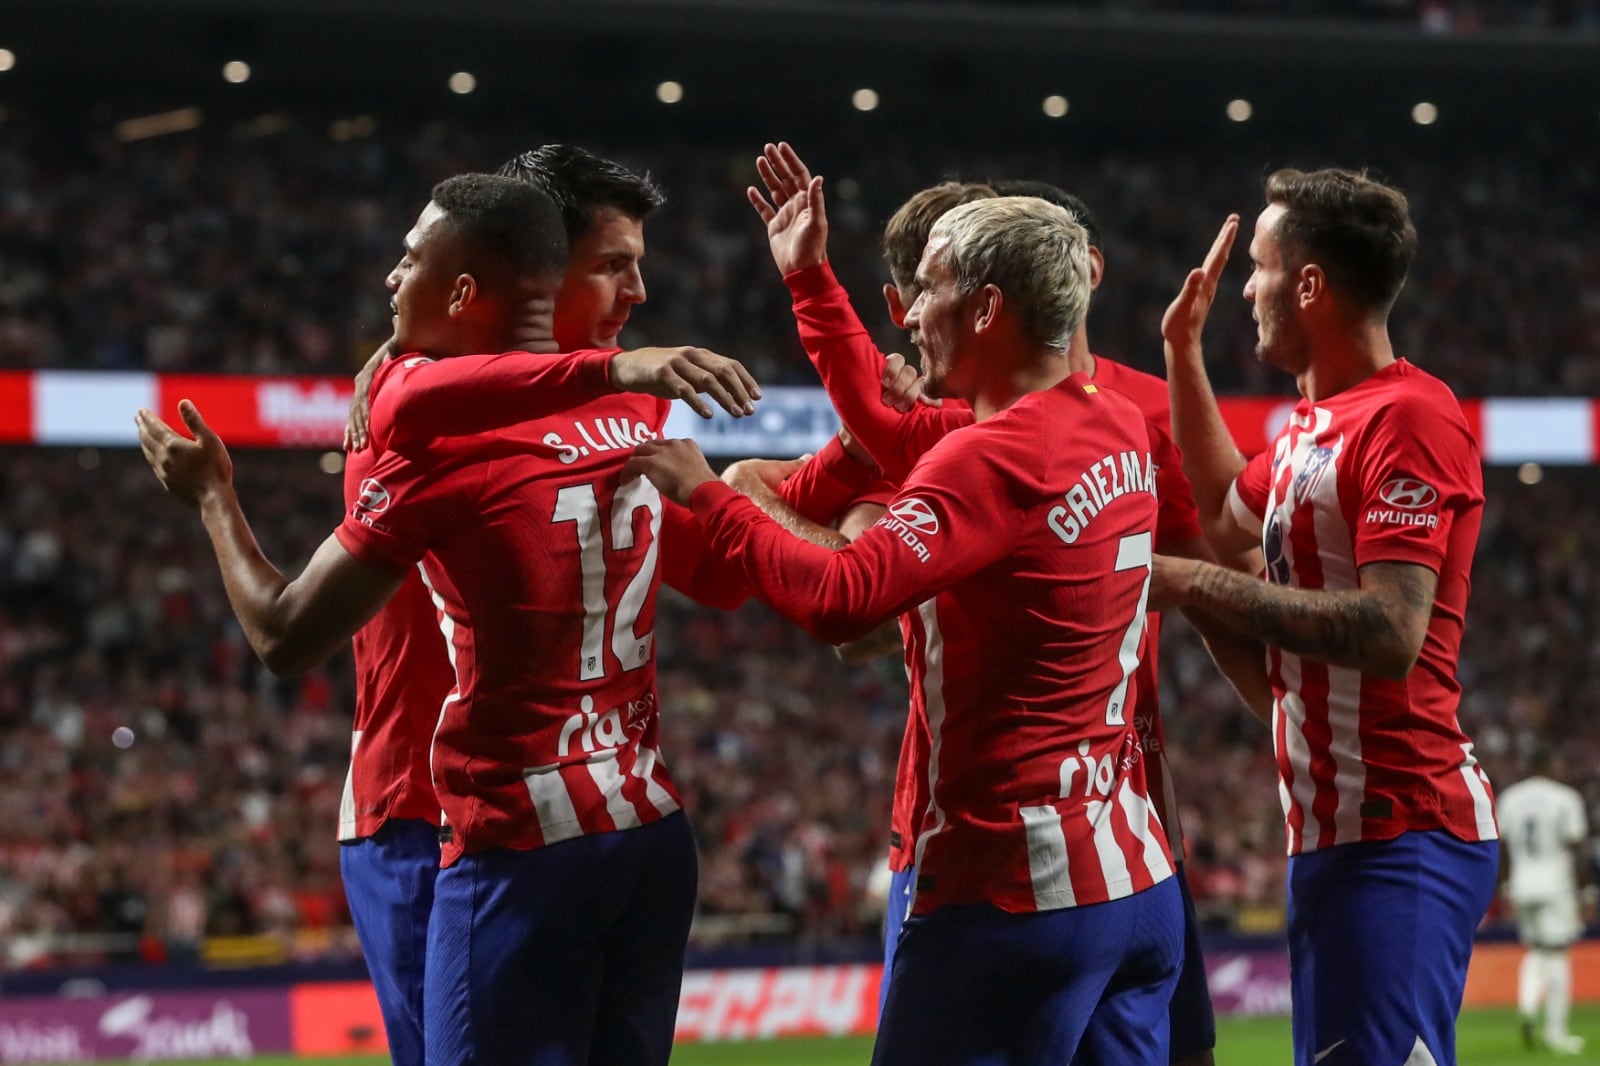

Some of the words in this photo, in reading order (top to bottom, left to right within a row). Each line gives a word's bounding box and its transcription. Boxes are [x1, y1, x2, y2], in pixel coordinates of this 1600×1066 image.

[551, 473, 663, 681] 12
[1105, 531, 1152, 726] 7
[557, 694, 630, 757] ria
